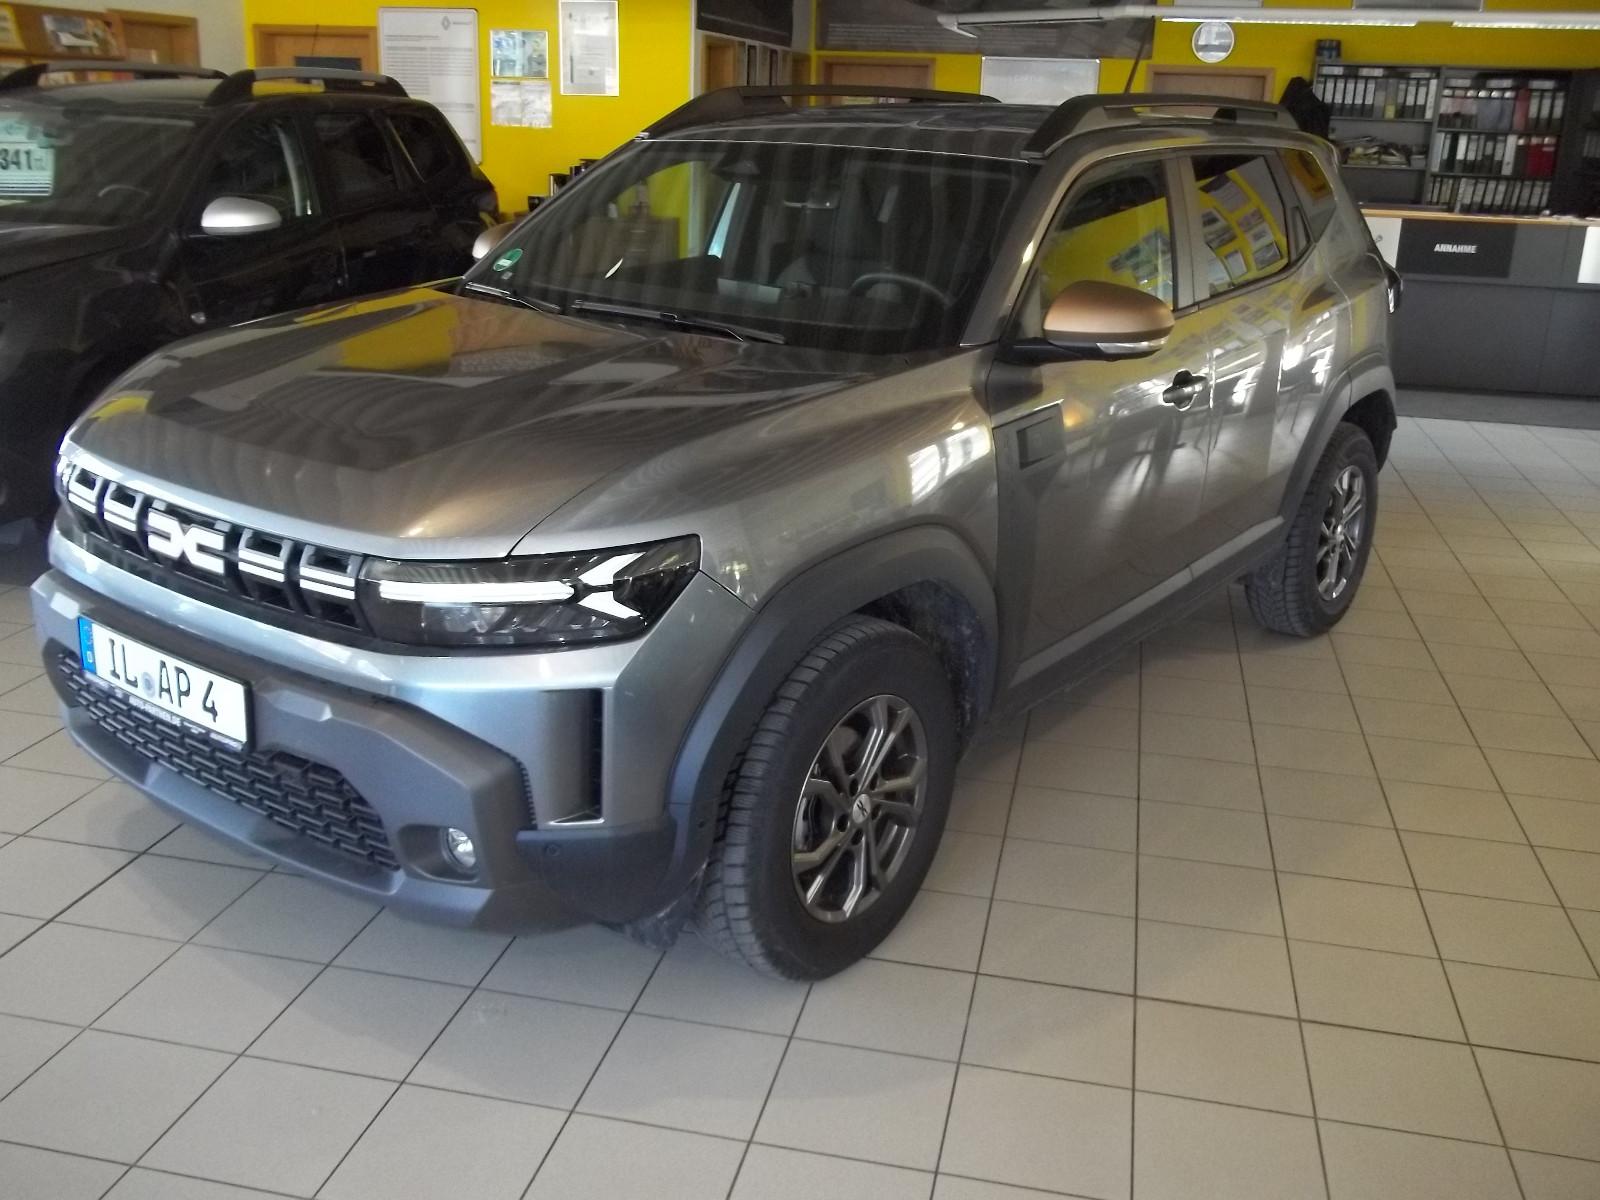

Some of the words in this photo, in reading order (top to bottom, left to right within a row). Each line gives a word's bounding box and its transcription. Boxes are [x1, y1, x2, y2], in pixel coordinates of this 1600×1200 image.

[1433, 243, 1477, 254] ANNAHME
[109, 638, 139, 689] IL
[159, 659, 191, 709] AP
[202, 680, 218, 723] 4
